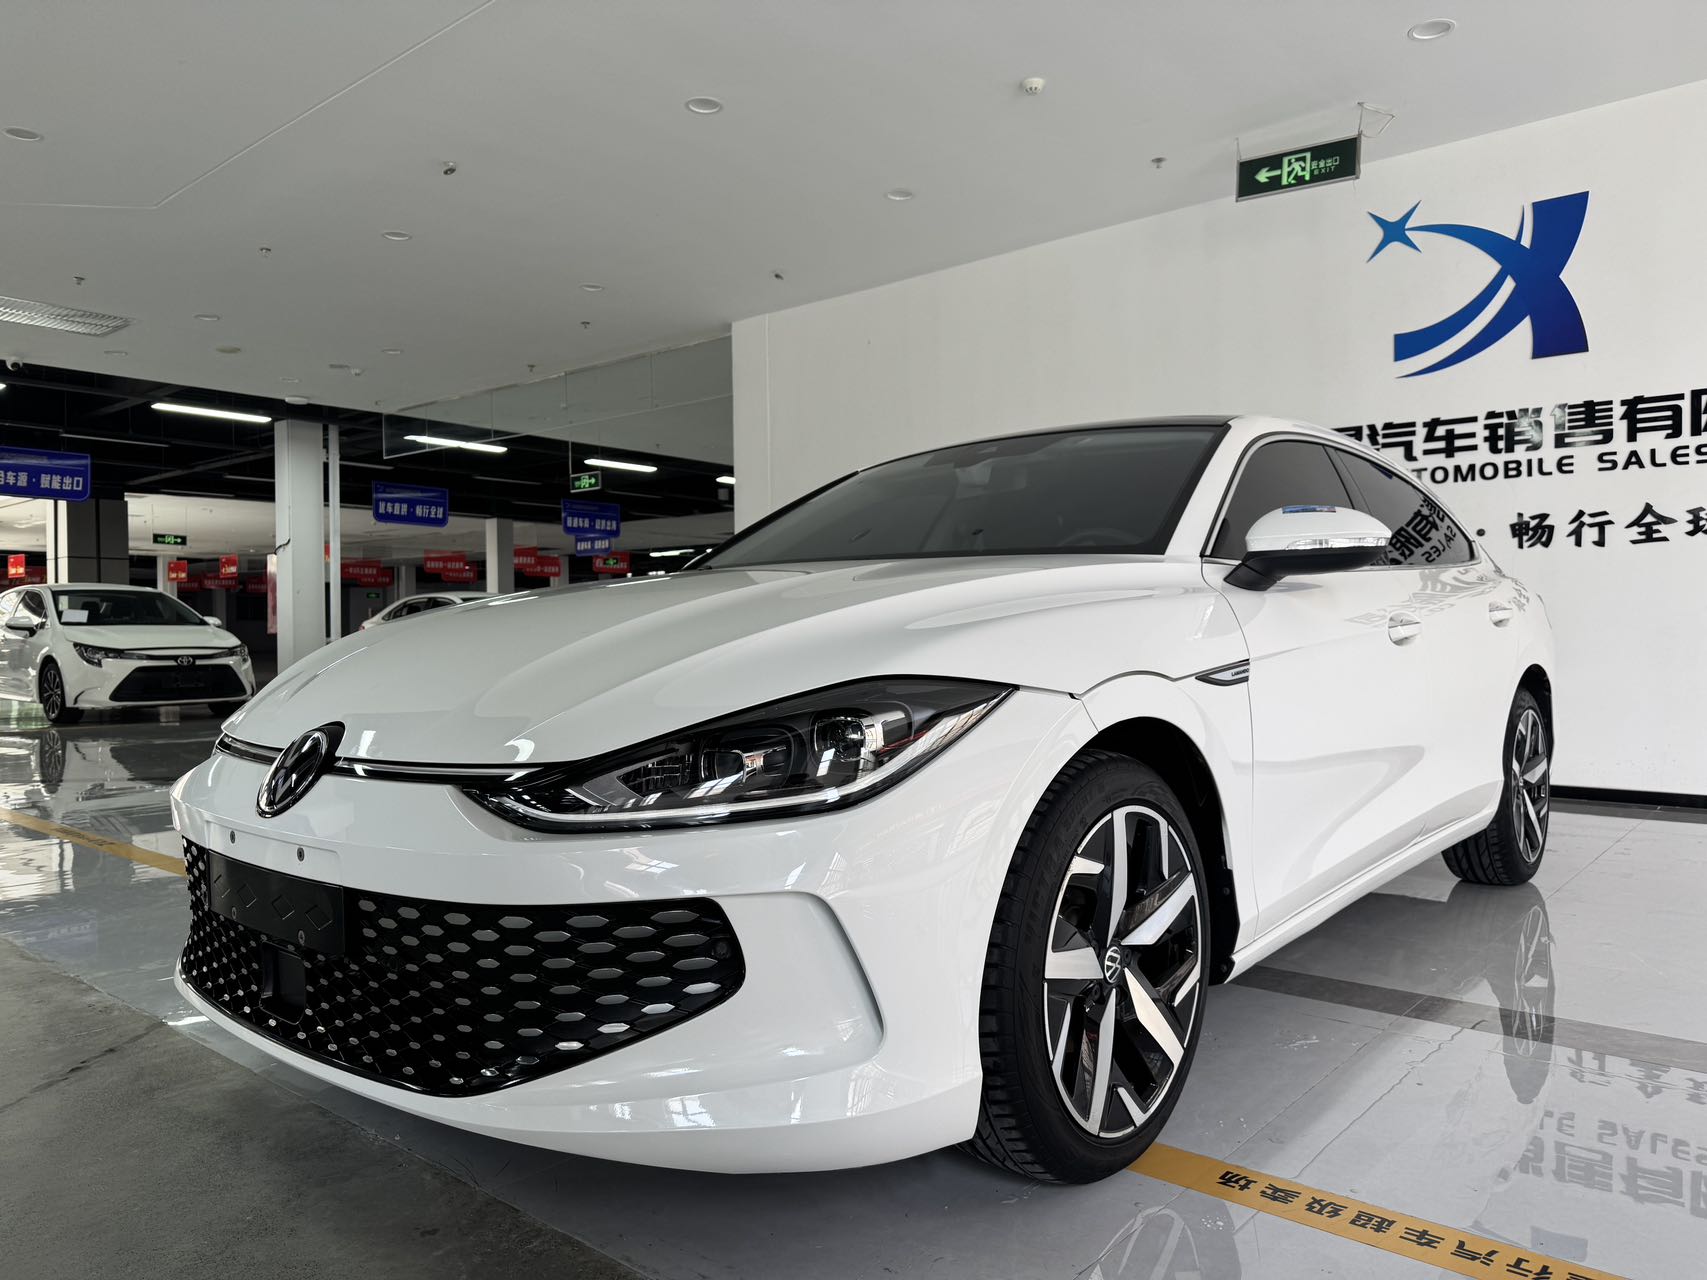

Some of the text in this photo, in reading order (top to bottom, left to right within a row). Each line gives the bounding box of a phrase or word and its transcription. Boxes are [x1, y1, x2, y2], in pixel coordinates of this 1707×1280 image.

[1311, 156, 1340, 169] 安全出口
[1314, 166, 1335, 174] EXIT
[1331, 388, 1707, 462] 汽车销售有
[1410, 443, 1707, 484] TOMOBILE SALES
